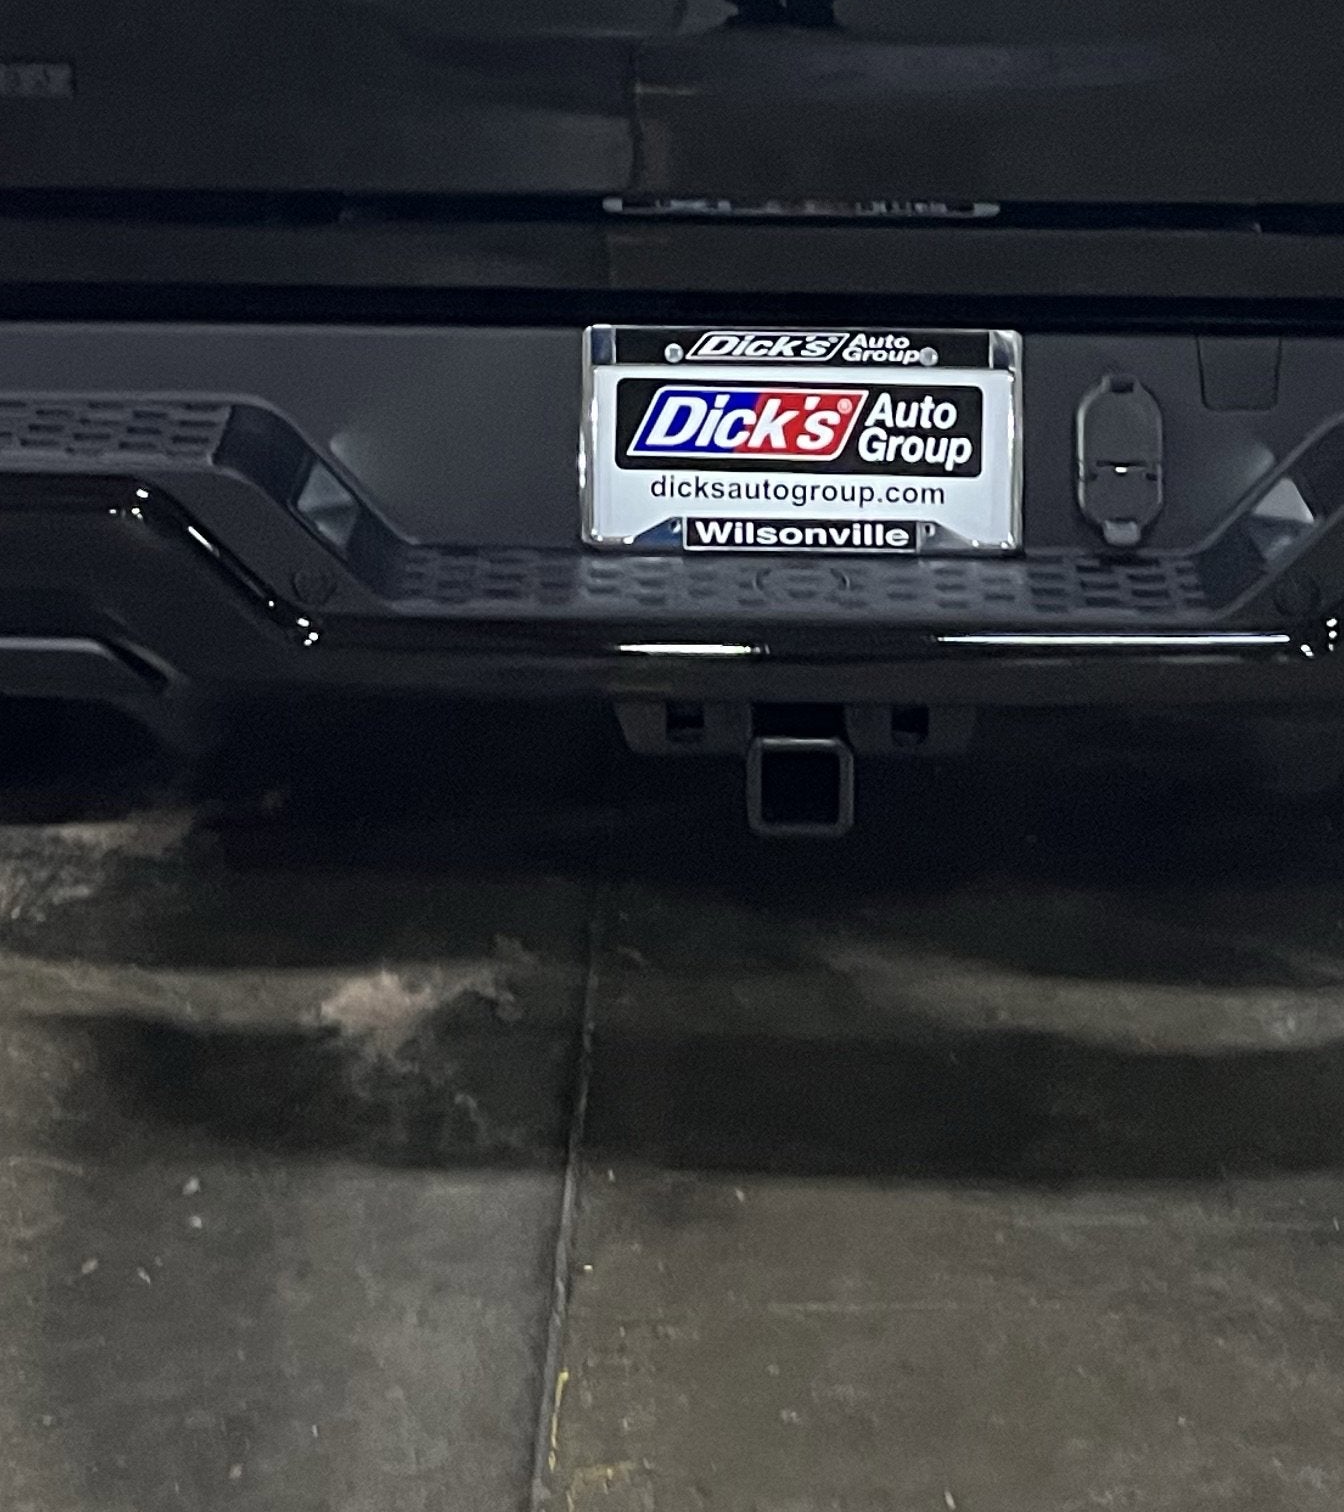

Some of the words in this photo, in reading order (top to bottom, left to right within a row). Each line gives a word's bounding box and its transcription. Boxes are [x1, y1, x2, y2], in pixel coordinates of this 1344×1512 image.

[843, 347, 921, 364] Group
[851, 334, 910, 348] Auto
[644, 391, 844, 451] Dick's
[864, 393, 958, 430] Auto
[858, 428, 973, 471] Group
[650, 476, 946, 507] dicksautogroup.com
[694, 520, 910, 547] Wilsonville
